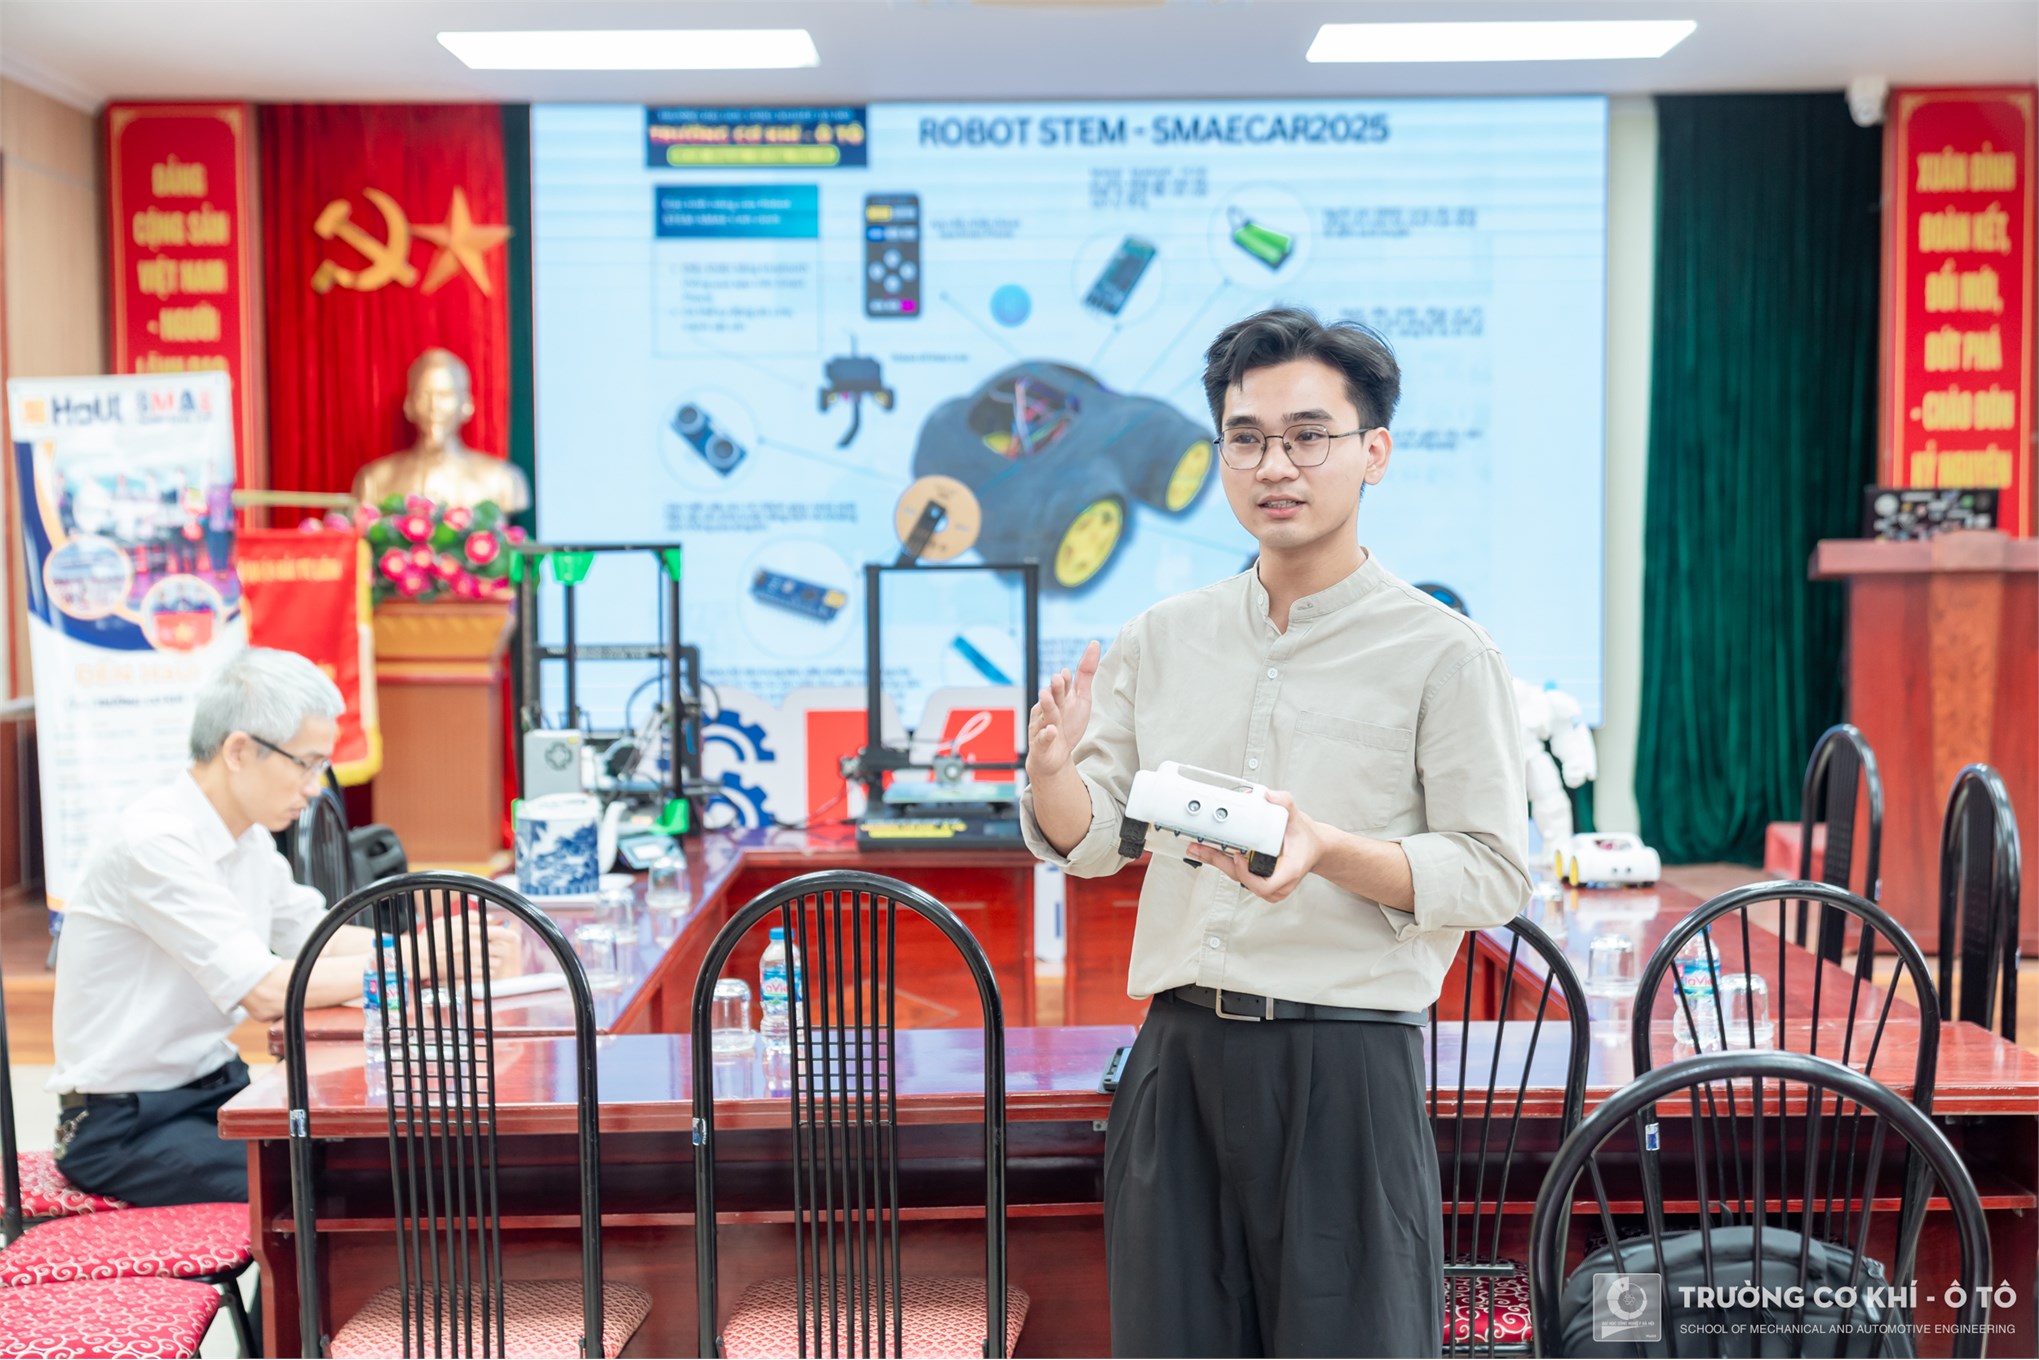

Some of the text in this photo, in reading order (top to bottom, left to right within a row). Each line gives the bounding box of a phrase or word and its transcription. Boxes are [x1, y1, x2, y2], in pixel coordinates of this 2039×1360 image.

[920, 117, 1031, 146] ROBOT
[1039, 116, 1127, 146] STEM
[1152, 114, 1391, 145] SMAECAR2025
